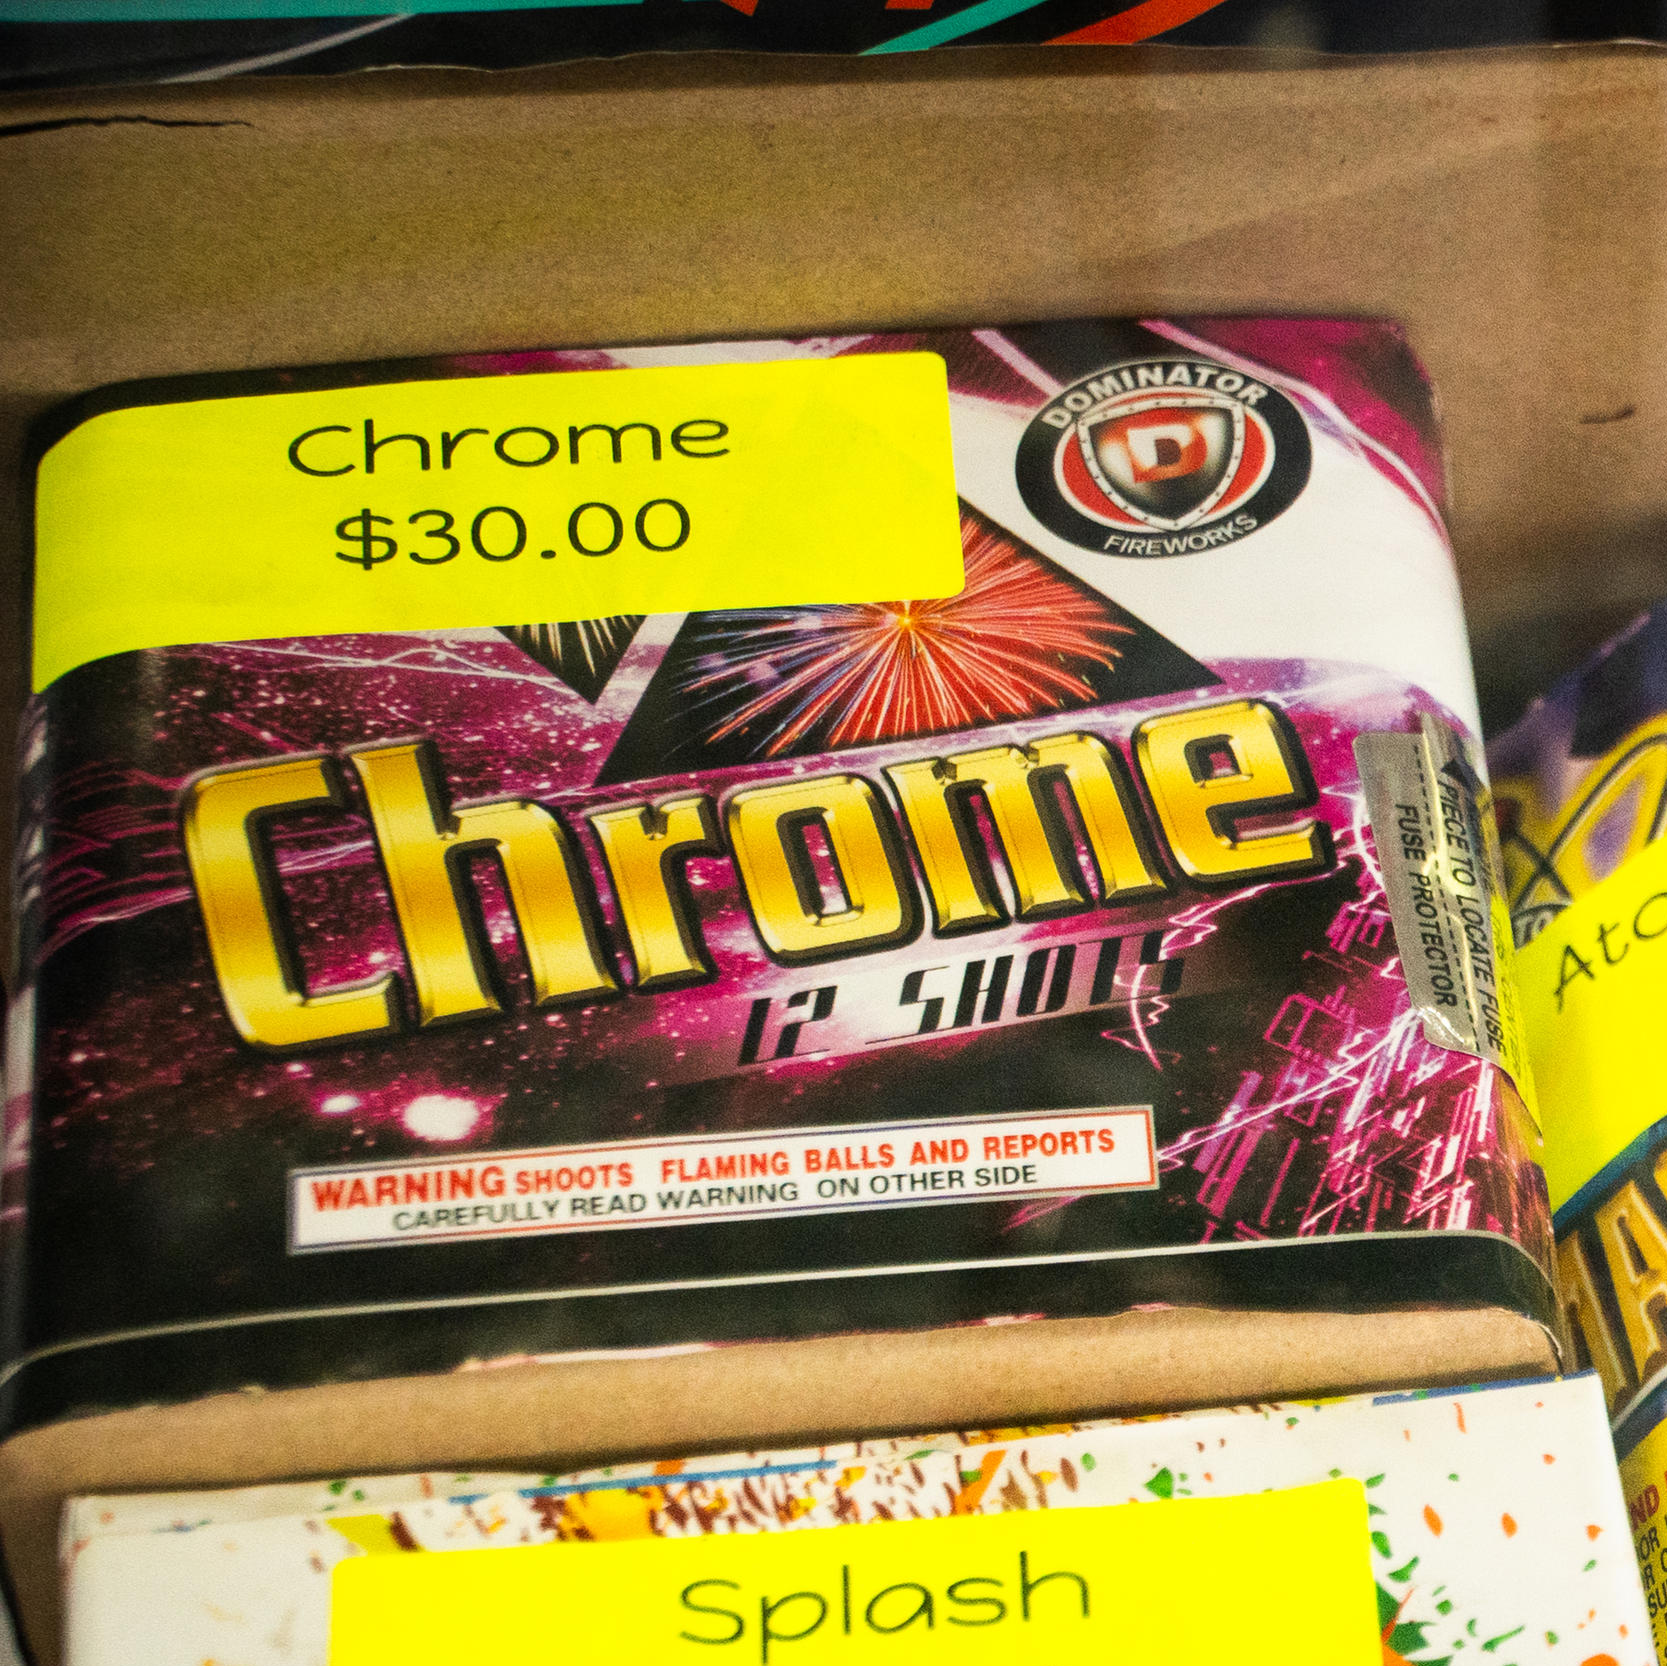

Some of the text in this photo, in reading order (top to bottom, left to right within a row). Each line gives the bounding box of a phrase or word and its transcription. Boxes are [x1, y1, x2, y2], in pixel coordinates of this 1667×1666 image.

[1041, 359, 1270, 431] DOMINATOR
[286, 418, 731, 478] Chrome
[334, 498, 692, 571] $30.00
[1103, 512, 1259, 558] FIREWORKS
[181, 700, 1338, 1055] Chrome
[1395, 803, 1458, 1008] FUSE PROTECTOR
[1449, 856, 1476, 888] TO
[1455, 894, 1495, 985] LOCATE
[880, 928, 1186, 1044] SHOTS
[1481, 998, 1508, 1057] FUSE
[312, 1128, 1116, 1213] WARNING SHOOTS FLAMING BALLS AND REPORTS
[392, 1164, 1038, 1231] CAREFULLY READ WARNING ON OTHER SIDE
[677, 1549, 1092, 1666] Splash
